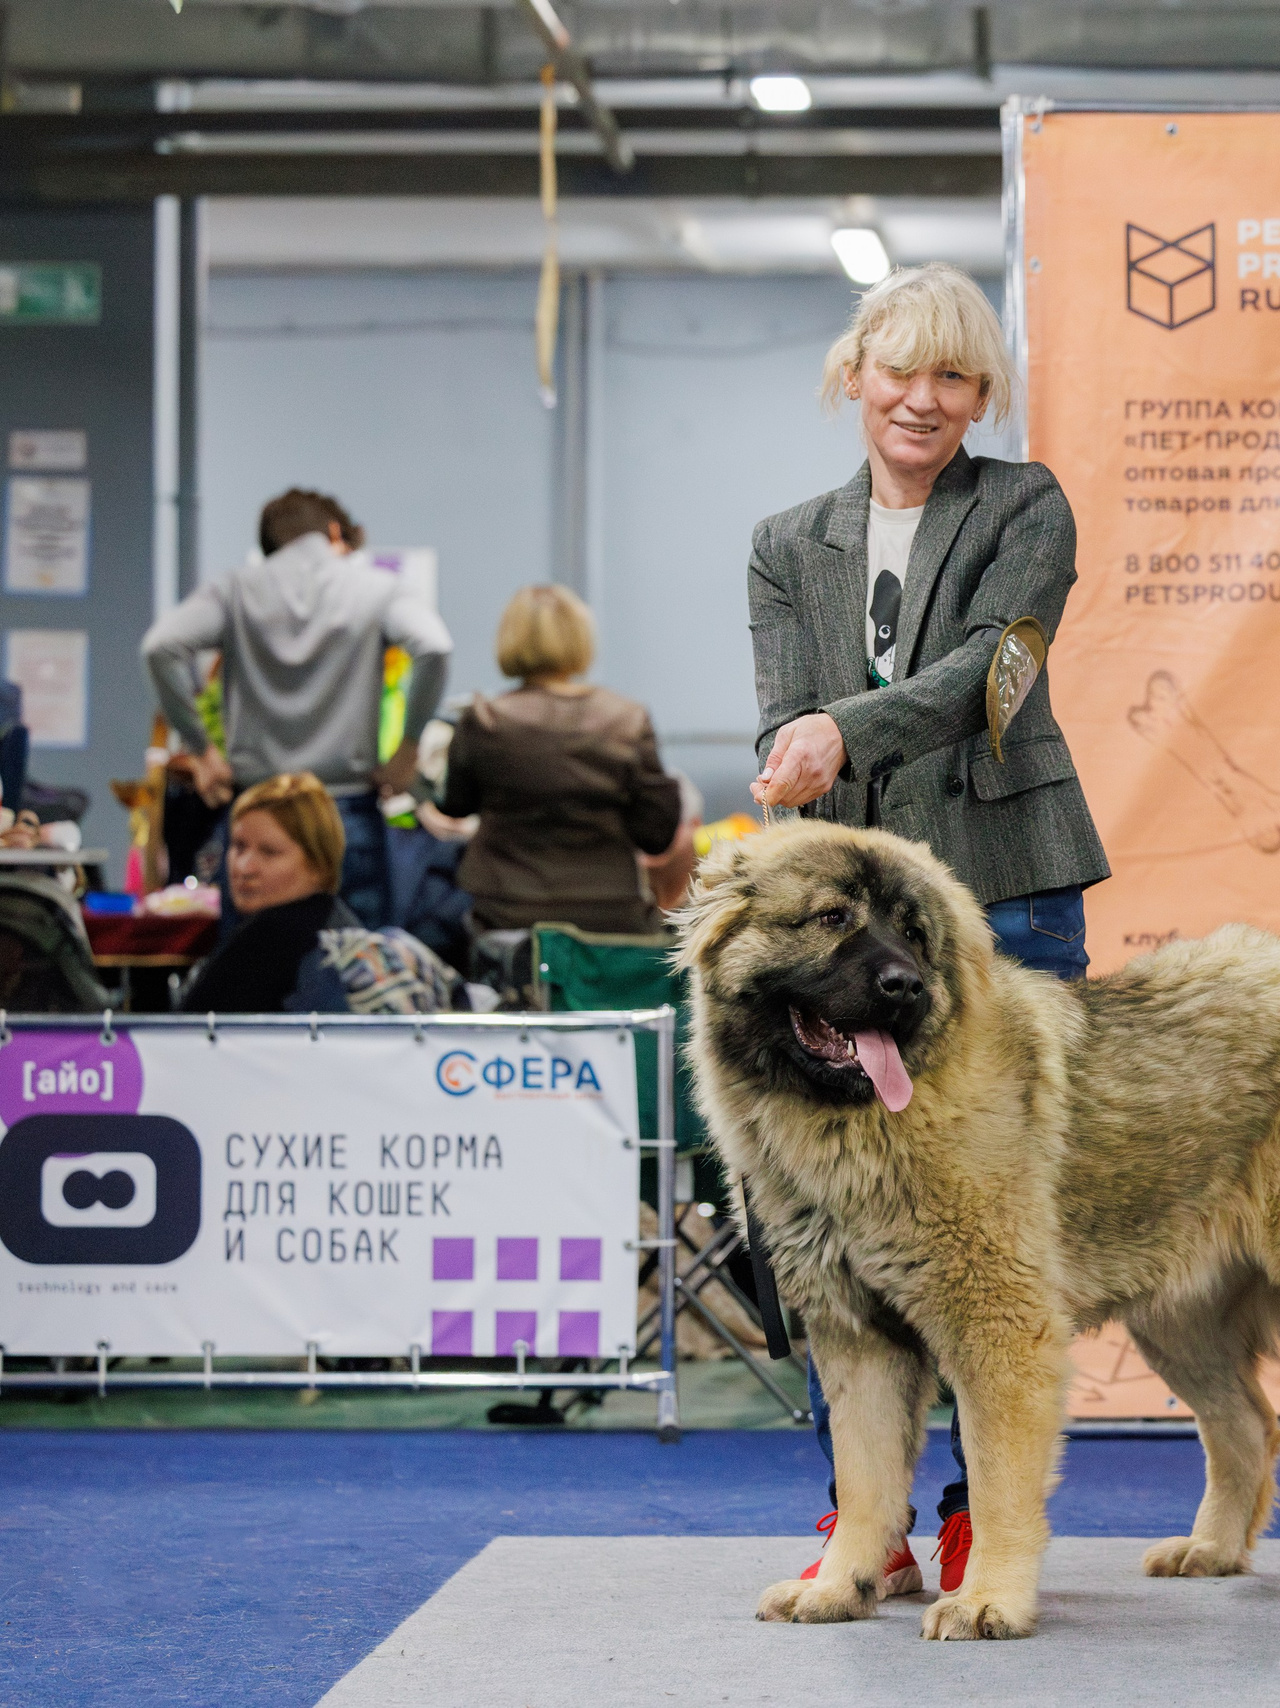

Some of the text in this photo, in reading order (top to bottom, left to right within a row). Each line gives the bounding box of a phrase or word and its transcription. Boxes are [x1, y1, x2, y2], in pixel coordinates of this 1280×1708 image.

[1124, 399, 1232, 420] ГРУППА
[1124, 465, 1231, 482] оптовая
[1124, 497, 1232, 516] товаров
[1125, 554, 1139, 574] 8
[1150, 553, 1200, 574] 800
[1210, 553, 1241, 573] 511
[436, 1050, 601, 1097] СФЕРА
[225, 1133, 503, 1169] СУХИЕ КОРМА
[223, 1180, 452, 1222] ДЛЯ КОШЕК
[225, 1228, 400, 1263] И СОБАК
